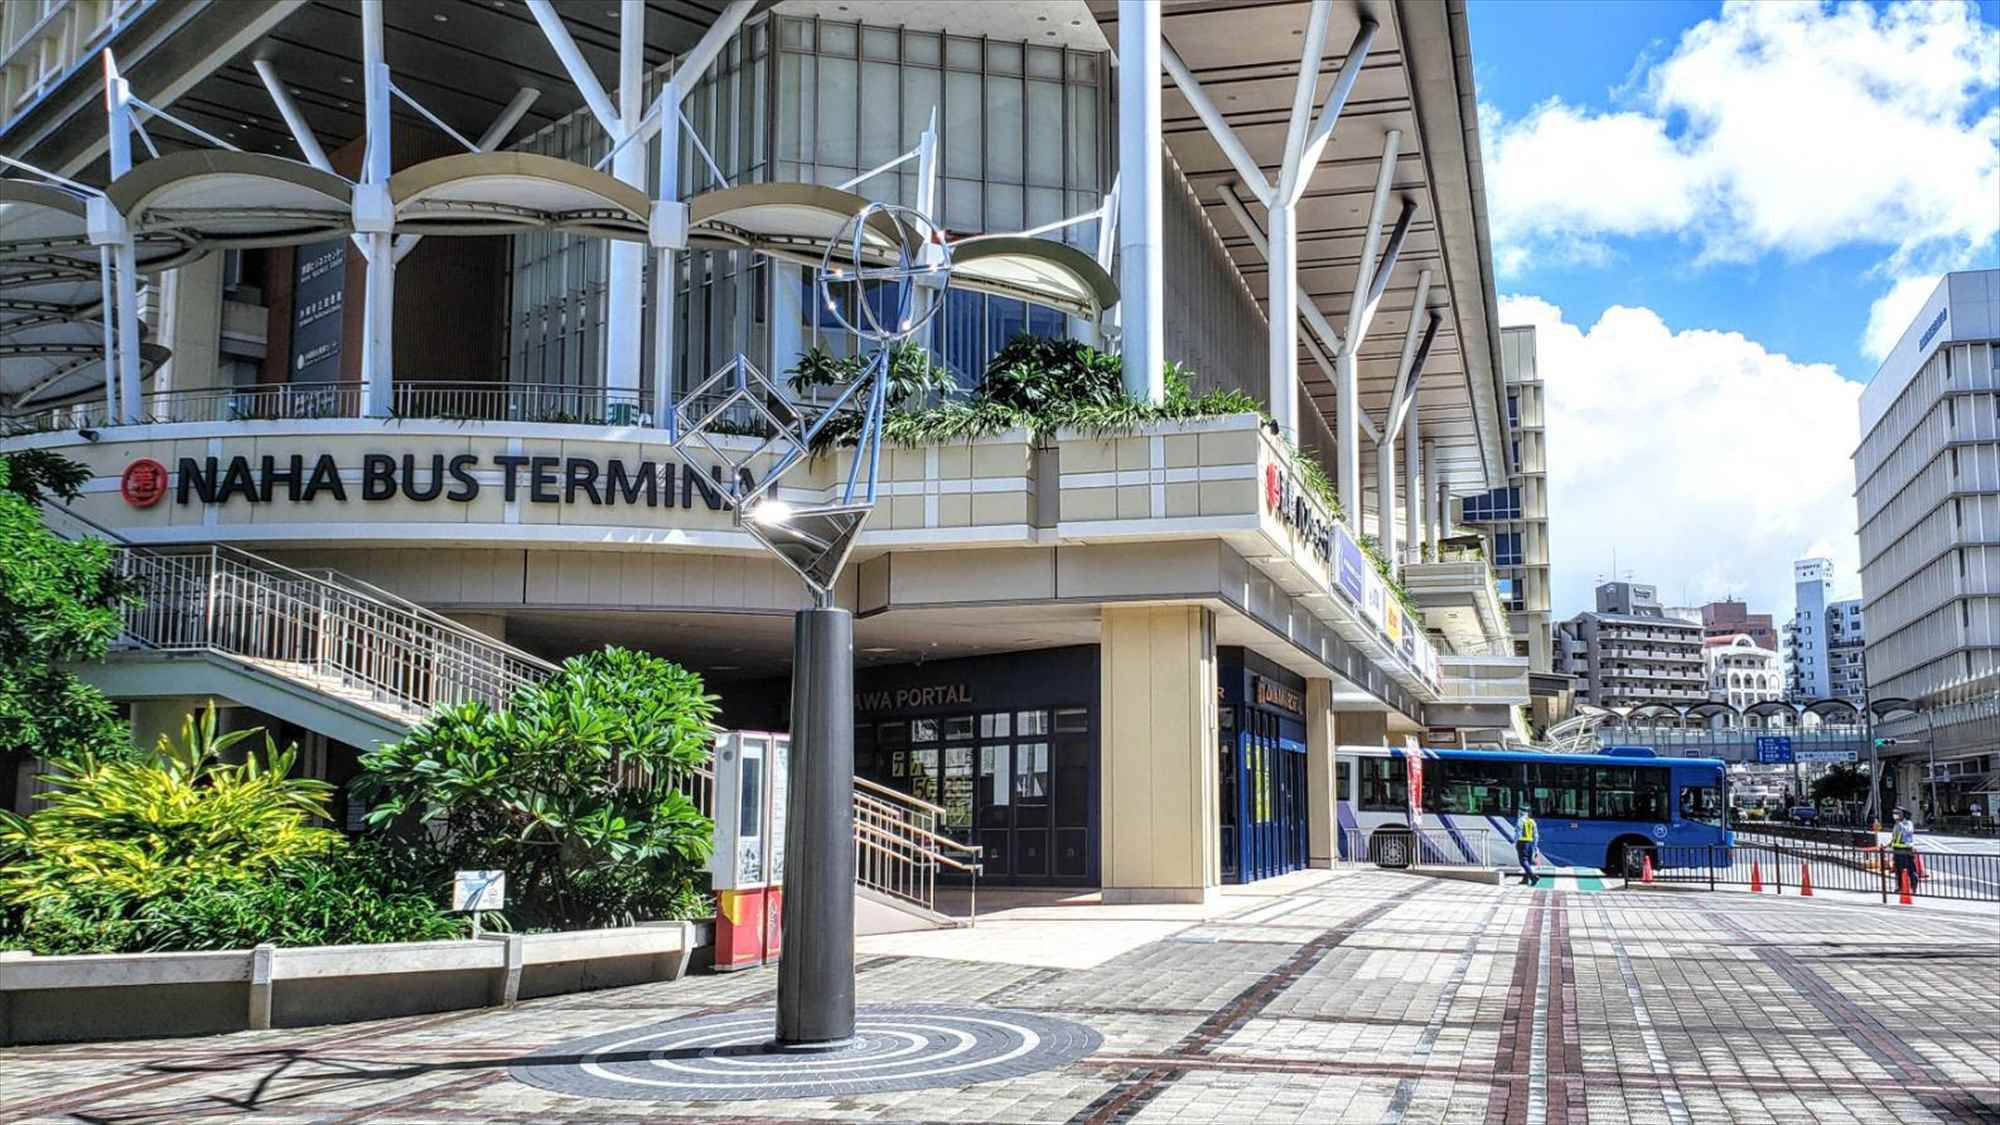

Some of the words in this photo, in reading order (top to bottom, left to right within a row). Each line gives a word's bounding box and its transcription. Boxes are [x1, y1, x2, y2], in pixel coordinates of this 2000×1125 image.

[177, 456, 346, 505] NAHA
[362, 453, 480, 502] BUS
[896, 685, 971, 707] PORTAL
